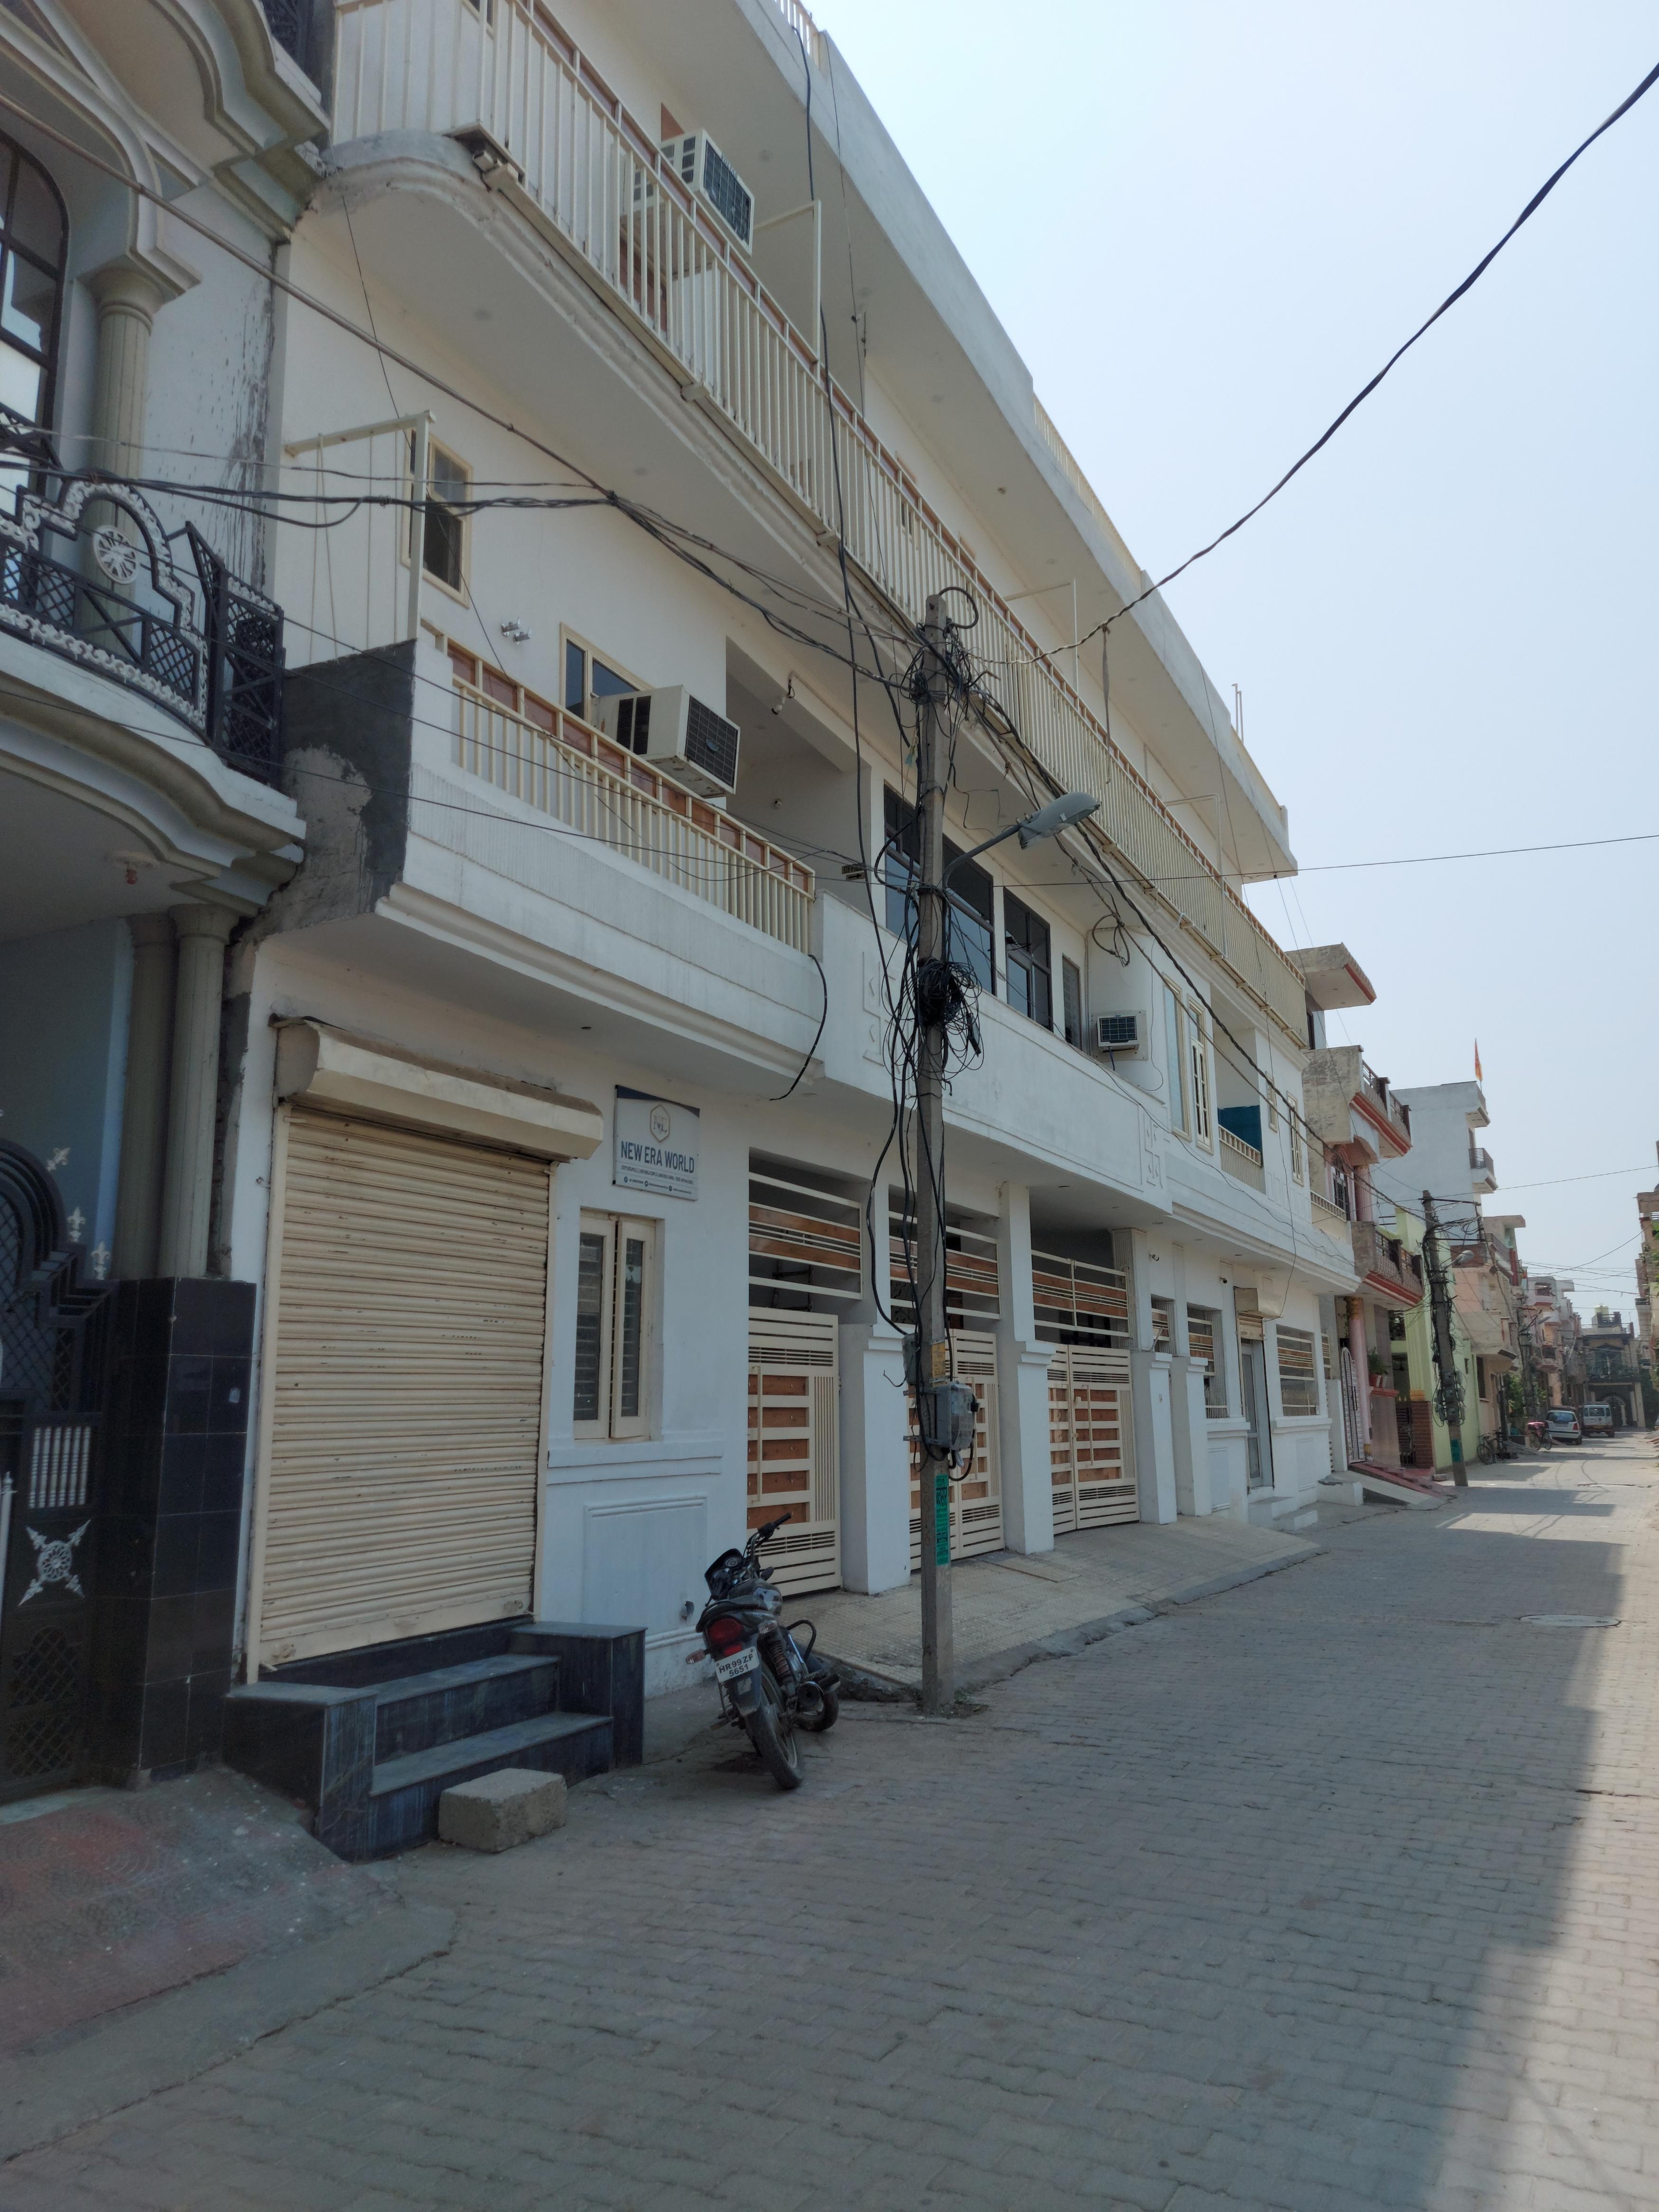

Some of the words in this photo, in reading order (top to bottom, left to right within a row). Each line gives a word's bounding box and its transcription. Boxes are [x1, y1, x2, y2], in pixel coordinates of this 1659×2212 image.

[621, 1141, 642, 1161] NEW
[644, 1146, 663, 1166] ERA
[664, 1151, 694, 1173] WORLD
[729, 1664, 749, 1677] 5651
